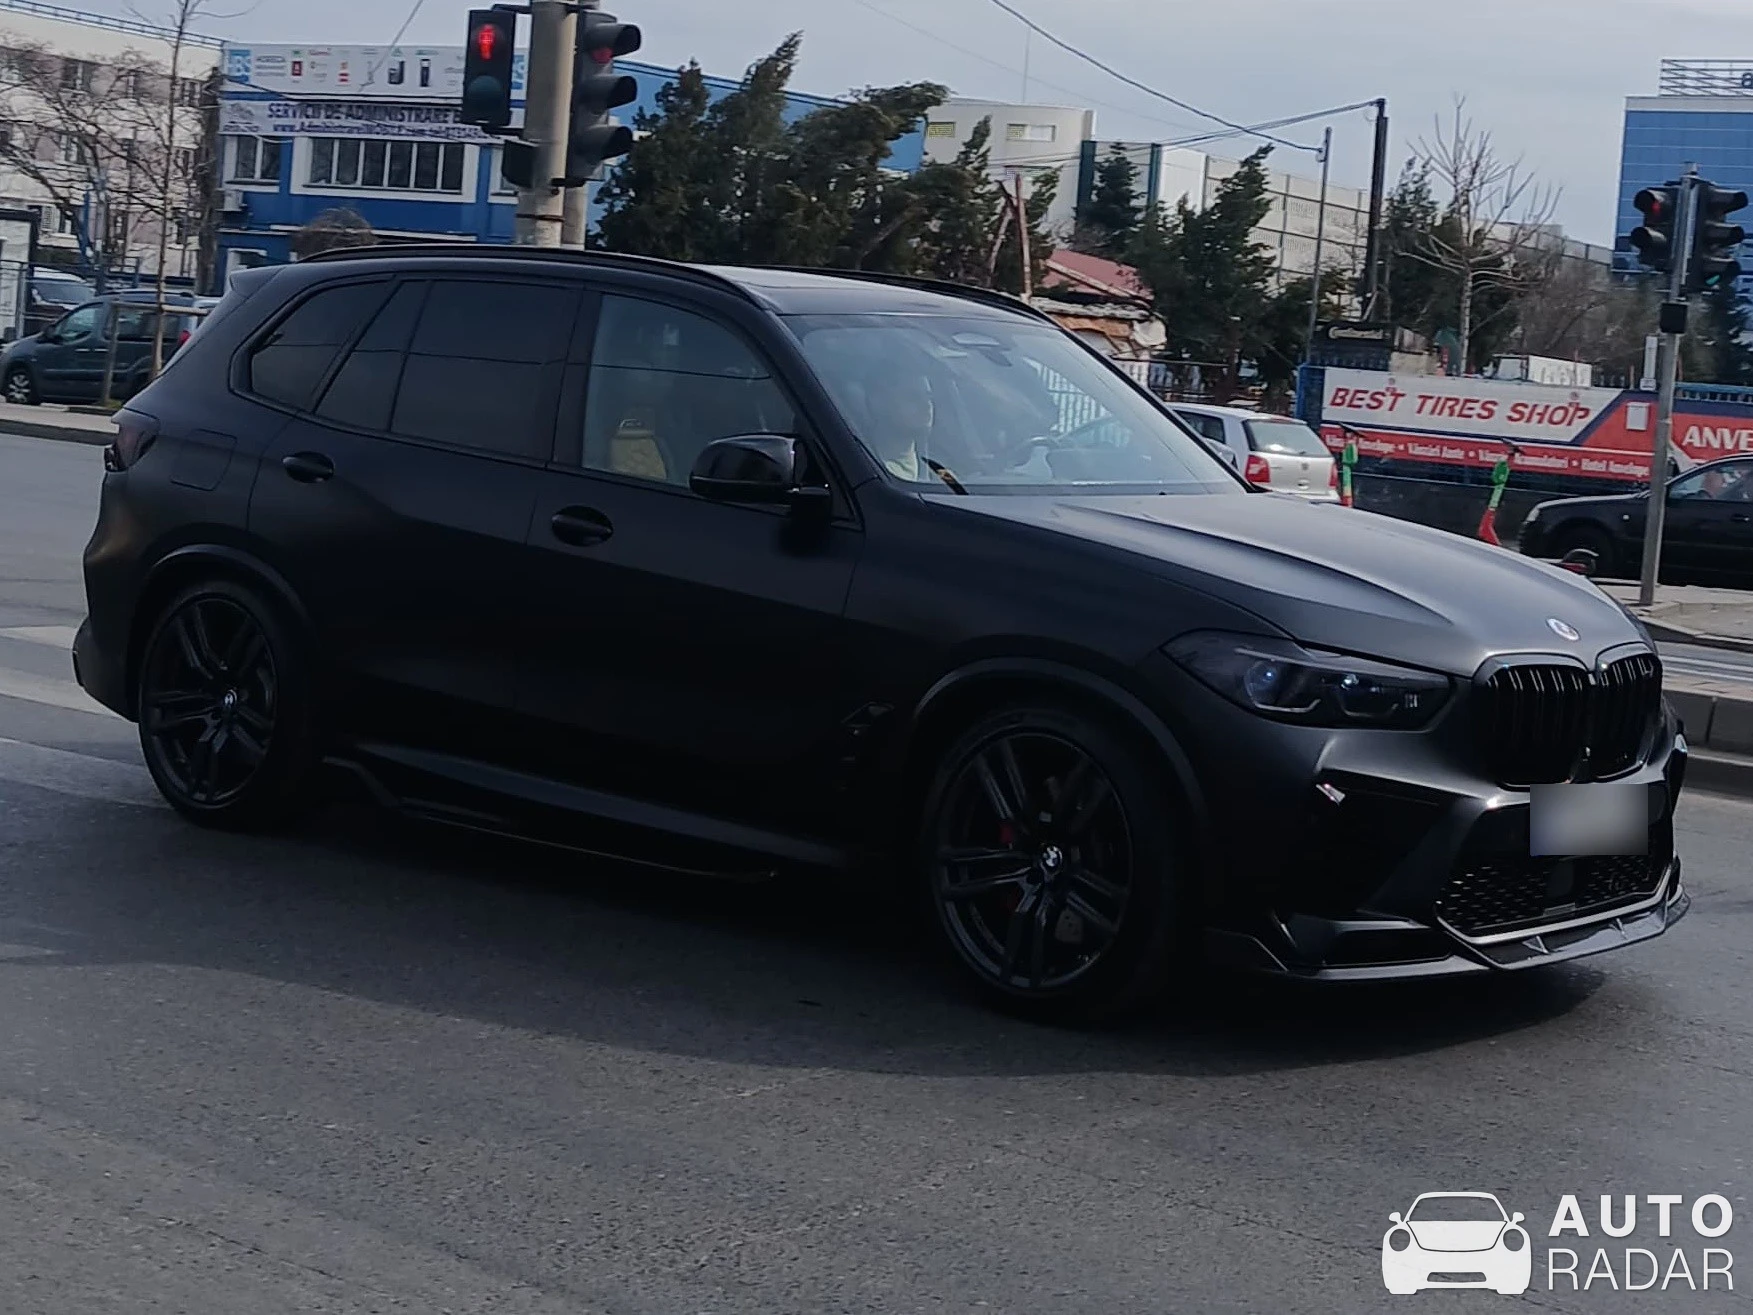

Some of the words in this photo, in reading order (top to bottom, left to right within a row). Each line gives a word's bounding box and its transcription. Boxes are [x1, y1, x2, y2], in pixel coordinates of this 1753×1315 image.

[1329, 386, 1407, 412] BEST
[1415, 394, 1499, 419] TIRES
[1505, 401, 1591, 427] SHOP
